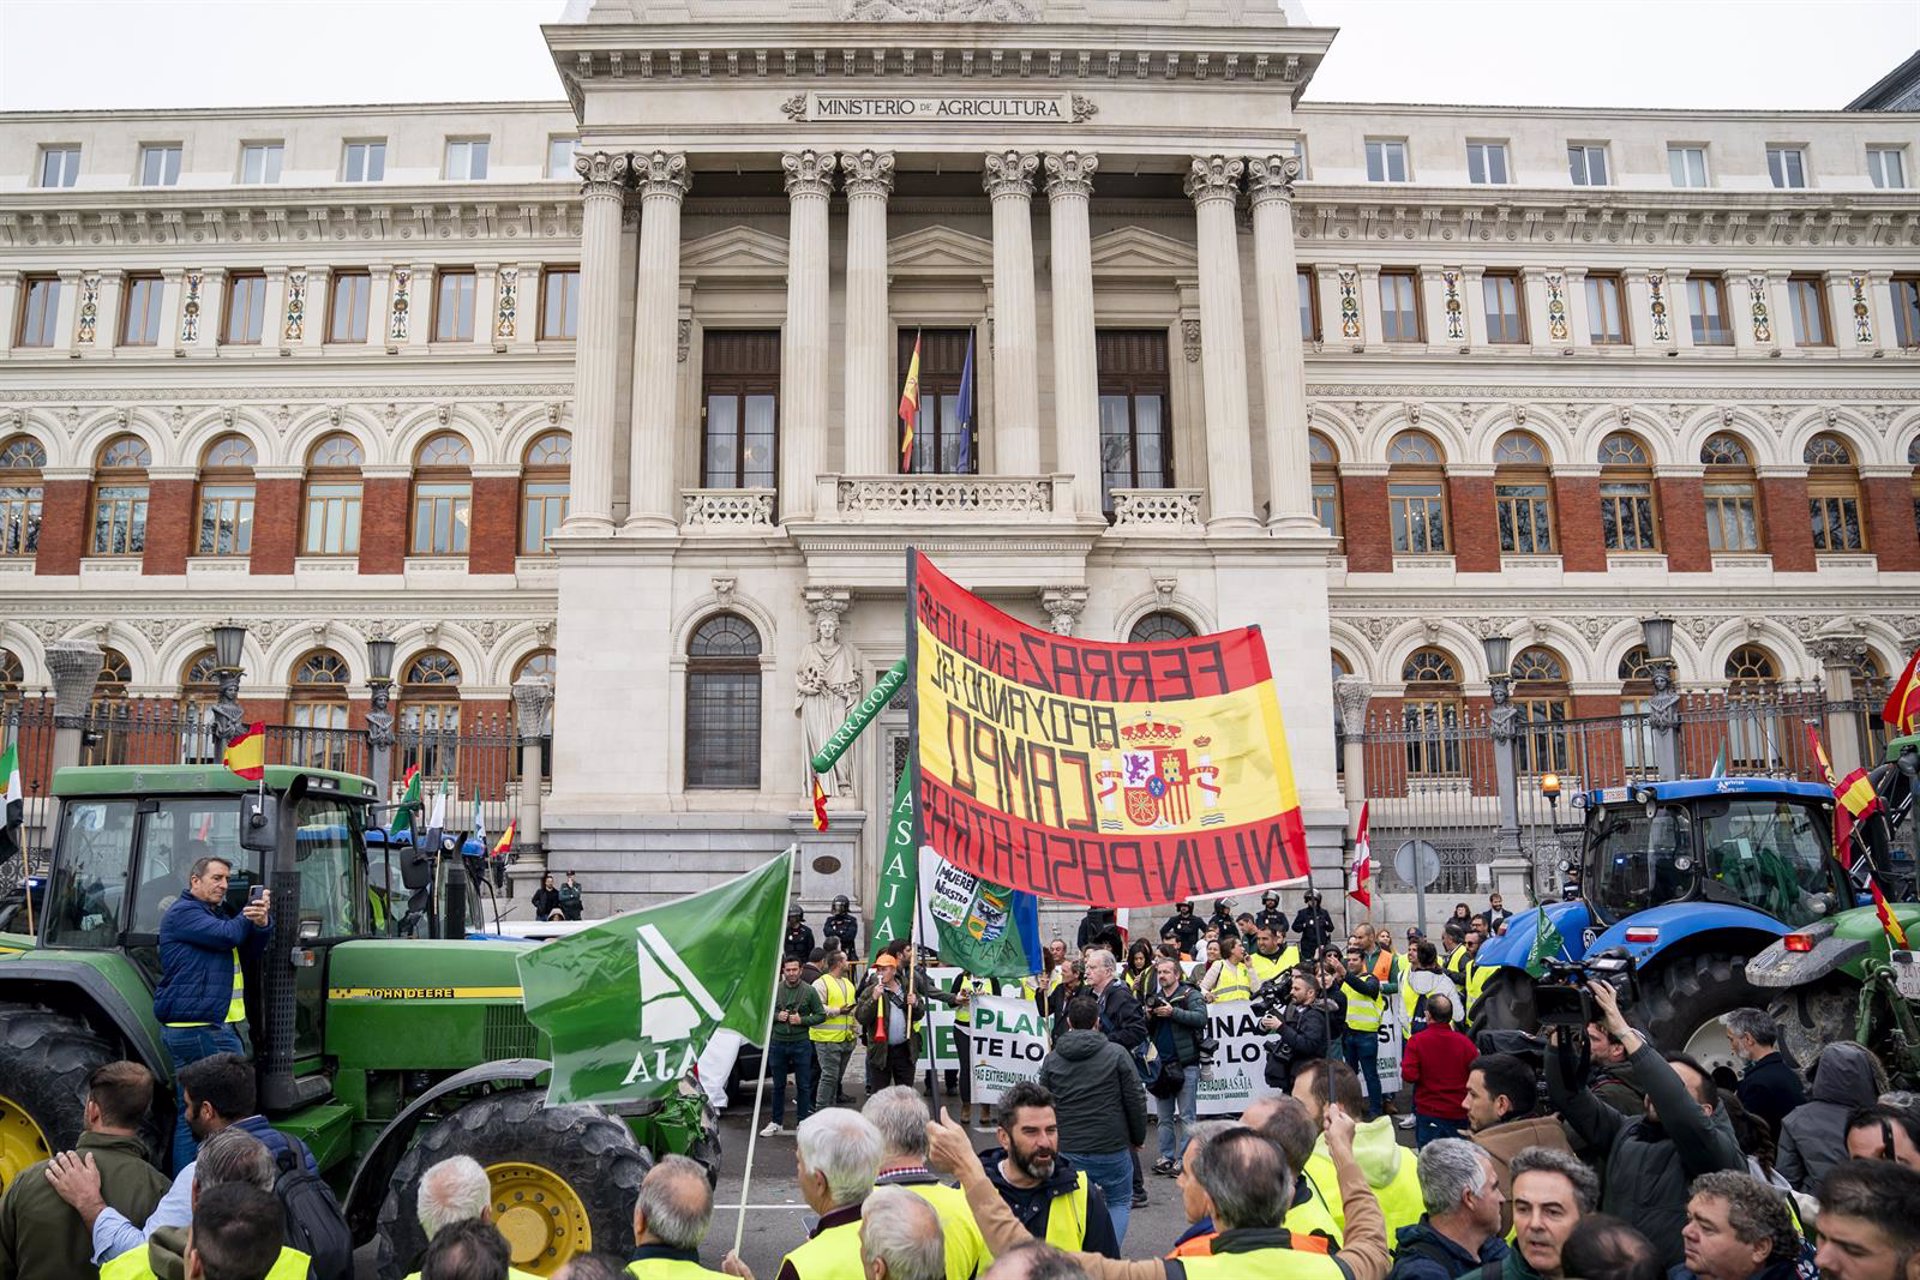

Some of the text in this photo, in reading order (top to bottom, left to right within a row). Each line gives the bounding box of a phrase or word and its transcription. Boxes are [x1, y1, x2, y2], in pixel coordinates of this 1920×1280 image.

[817, 99, 916, 116] MINISTERIO
[936, 99, 1061, 116] AGRICULTURA
[816, 667, 905, 764] TARRAGONA
[366, 987, 455, 998] JOHN DEERE
[973, 1036, 1003, 1057] TE
[1011, 1041, 1045, 1062] LO
[1226, 1043, 1260, 1063] LO
